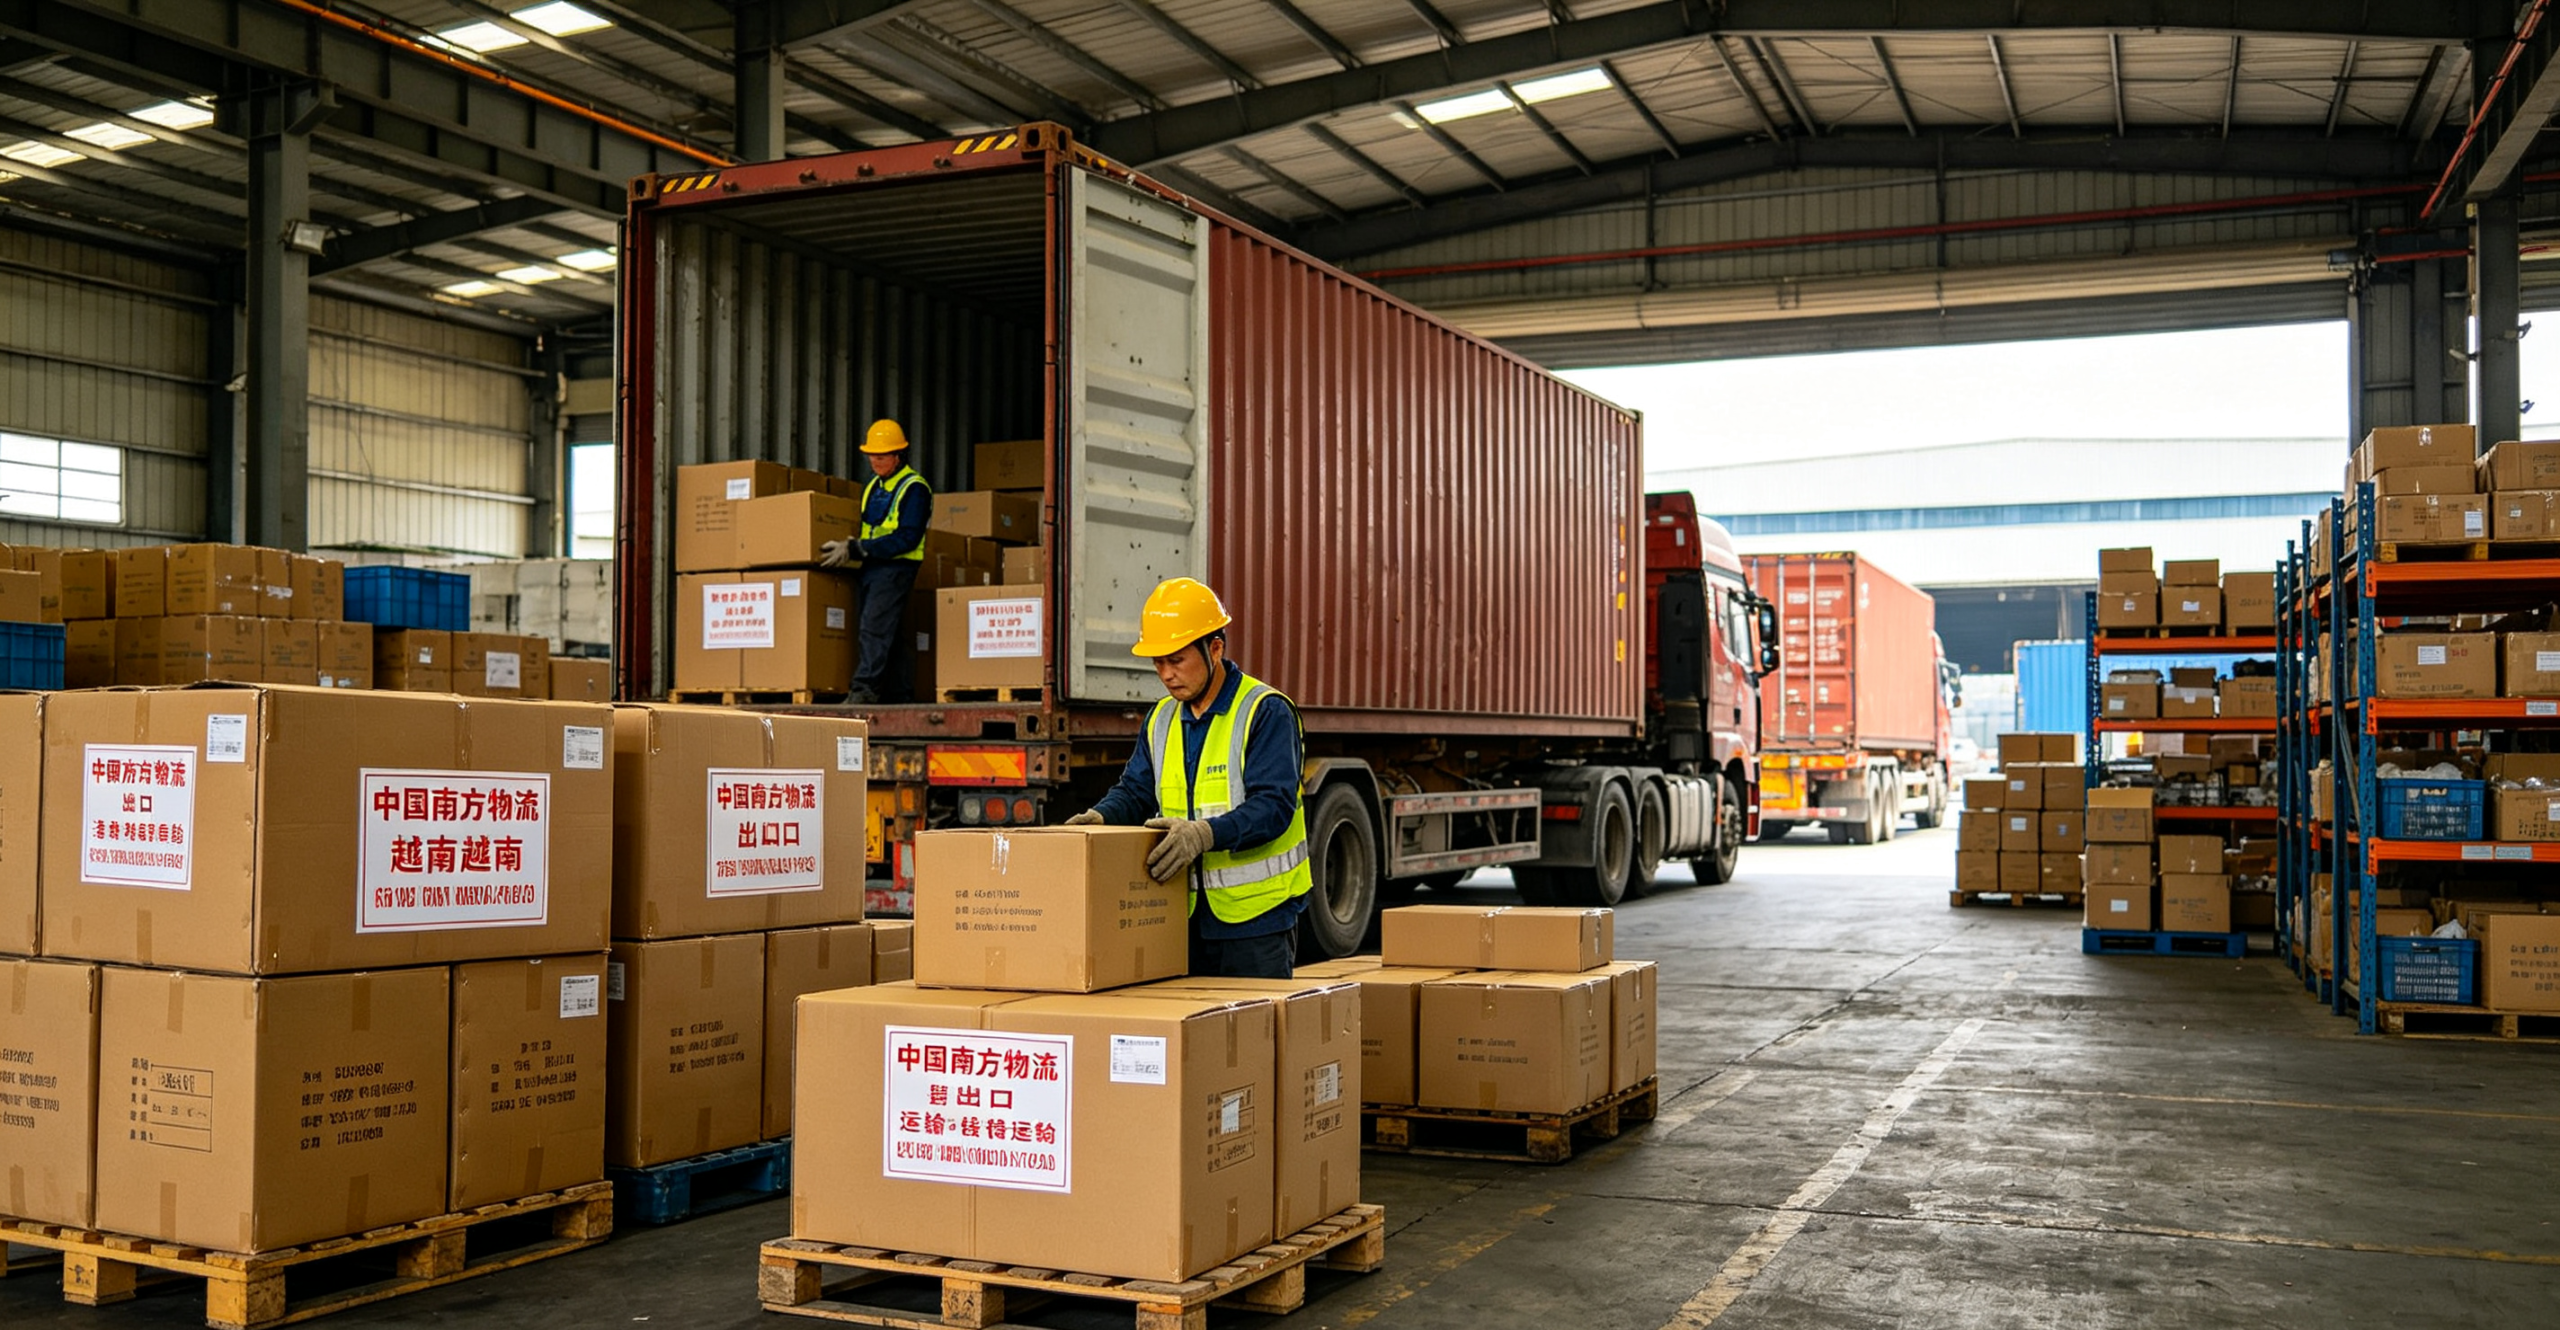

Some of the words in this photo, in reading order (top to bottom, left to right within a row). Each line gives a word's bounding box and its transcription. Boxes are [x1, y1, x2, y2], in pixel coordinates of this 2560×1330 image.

[374, 786, 538, 821] 中国南方物流
[391, 834, 523, 874] 越南越南
[897, 1043, 1058, 1081] 中国南方物流
